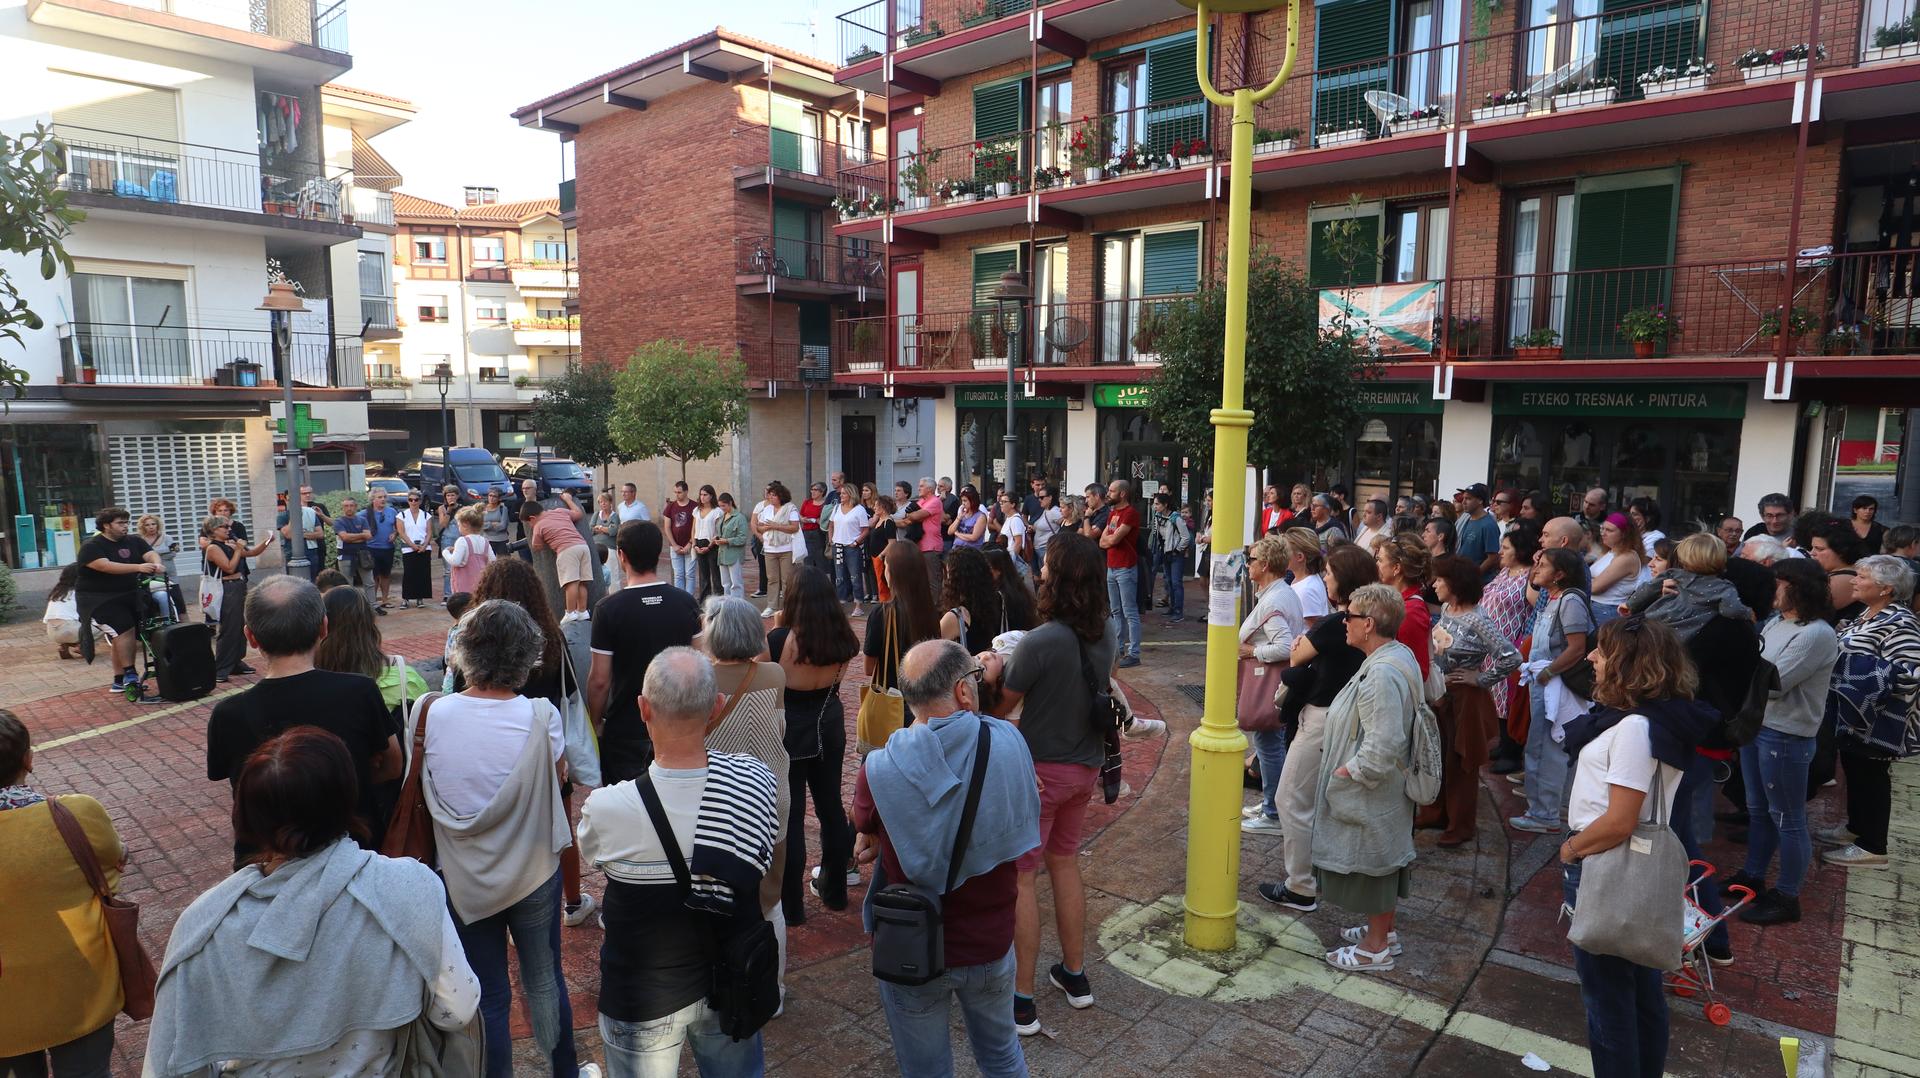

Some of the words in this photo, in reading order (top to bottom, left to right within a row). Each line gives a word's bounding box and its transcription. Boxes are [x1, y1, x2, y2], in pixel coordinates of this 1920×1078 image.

[1522, 392, 1570, 406] ETXEKO
[1574, 392, 1634, 407] TRESNAK
[1648, 393, 1708, 407] PINTURA
